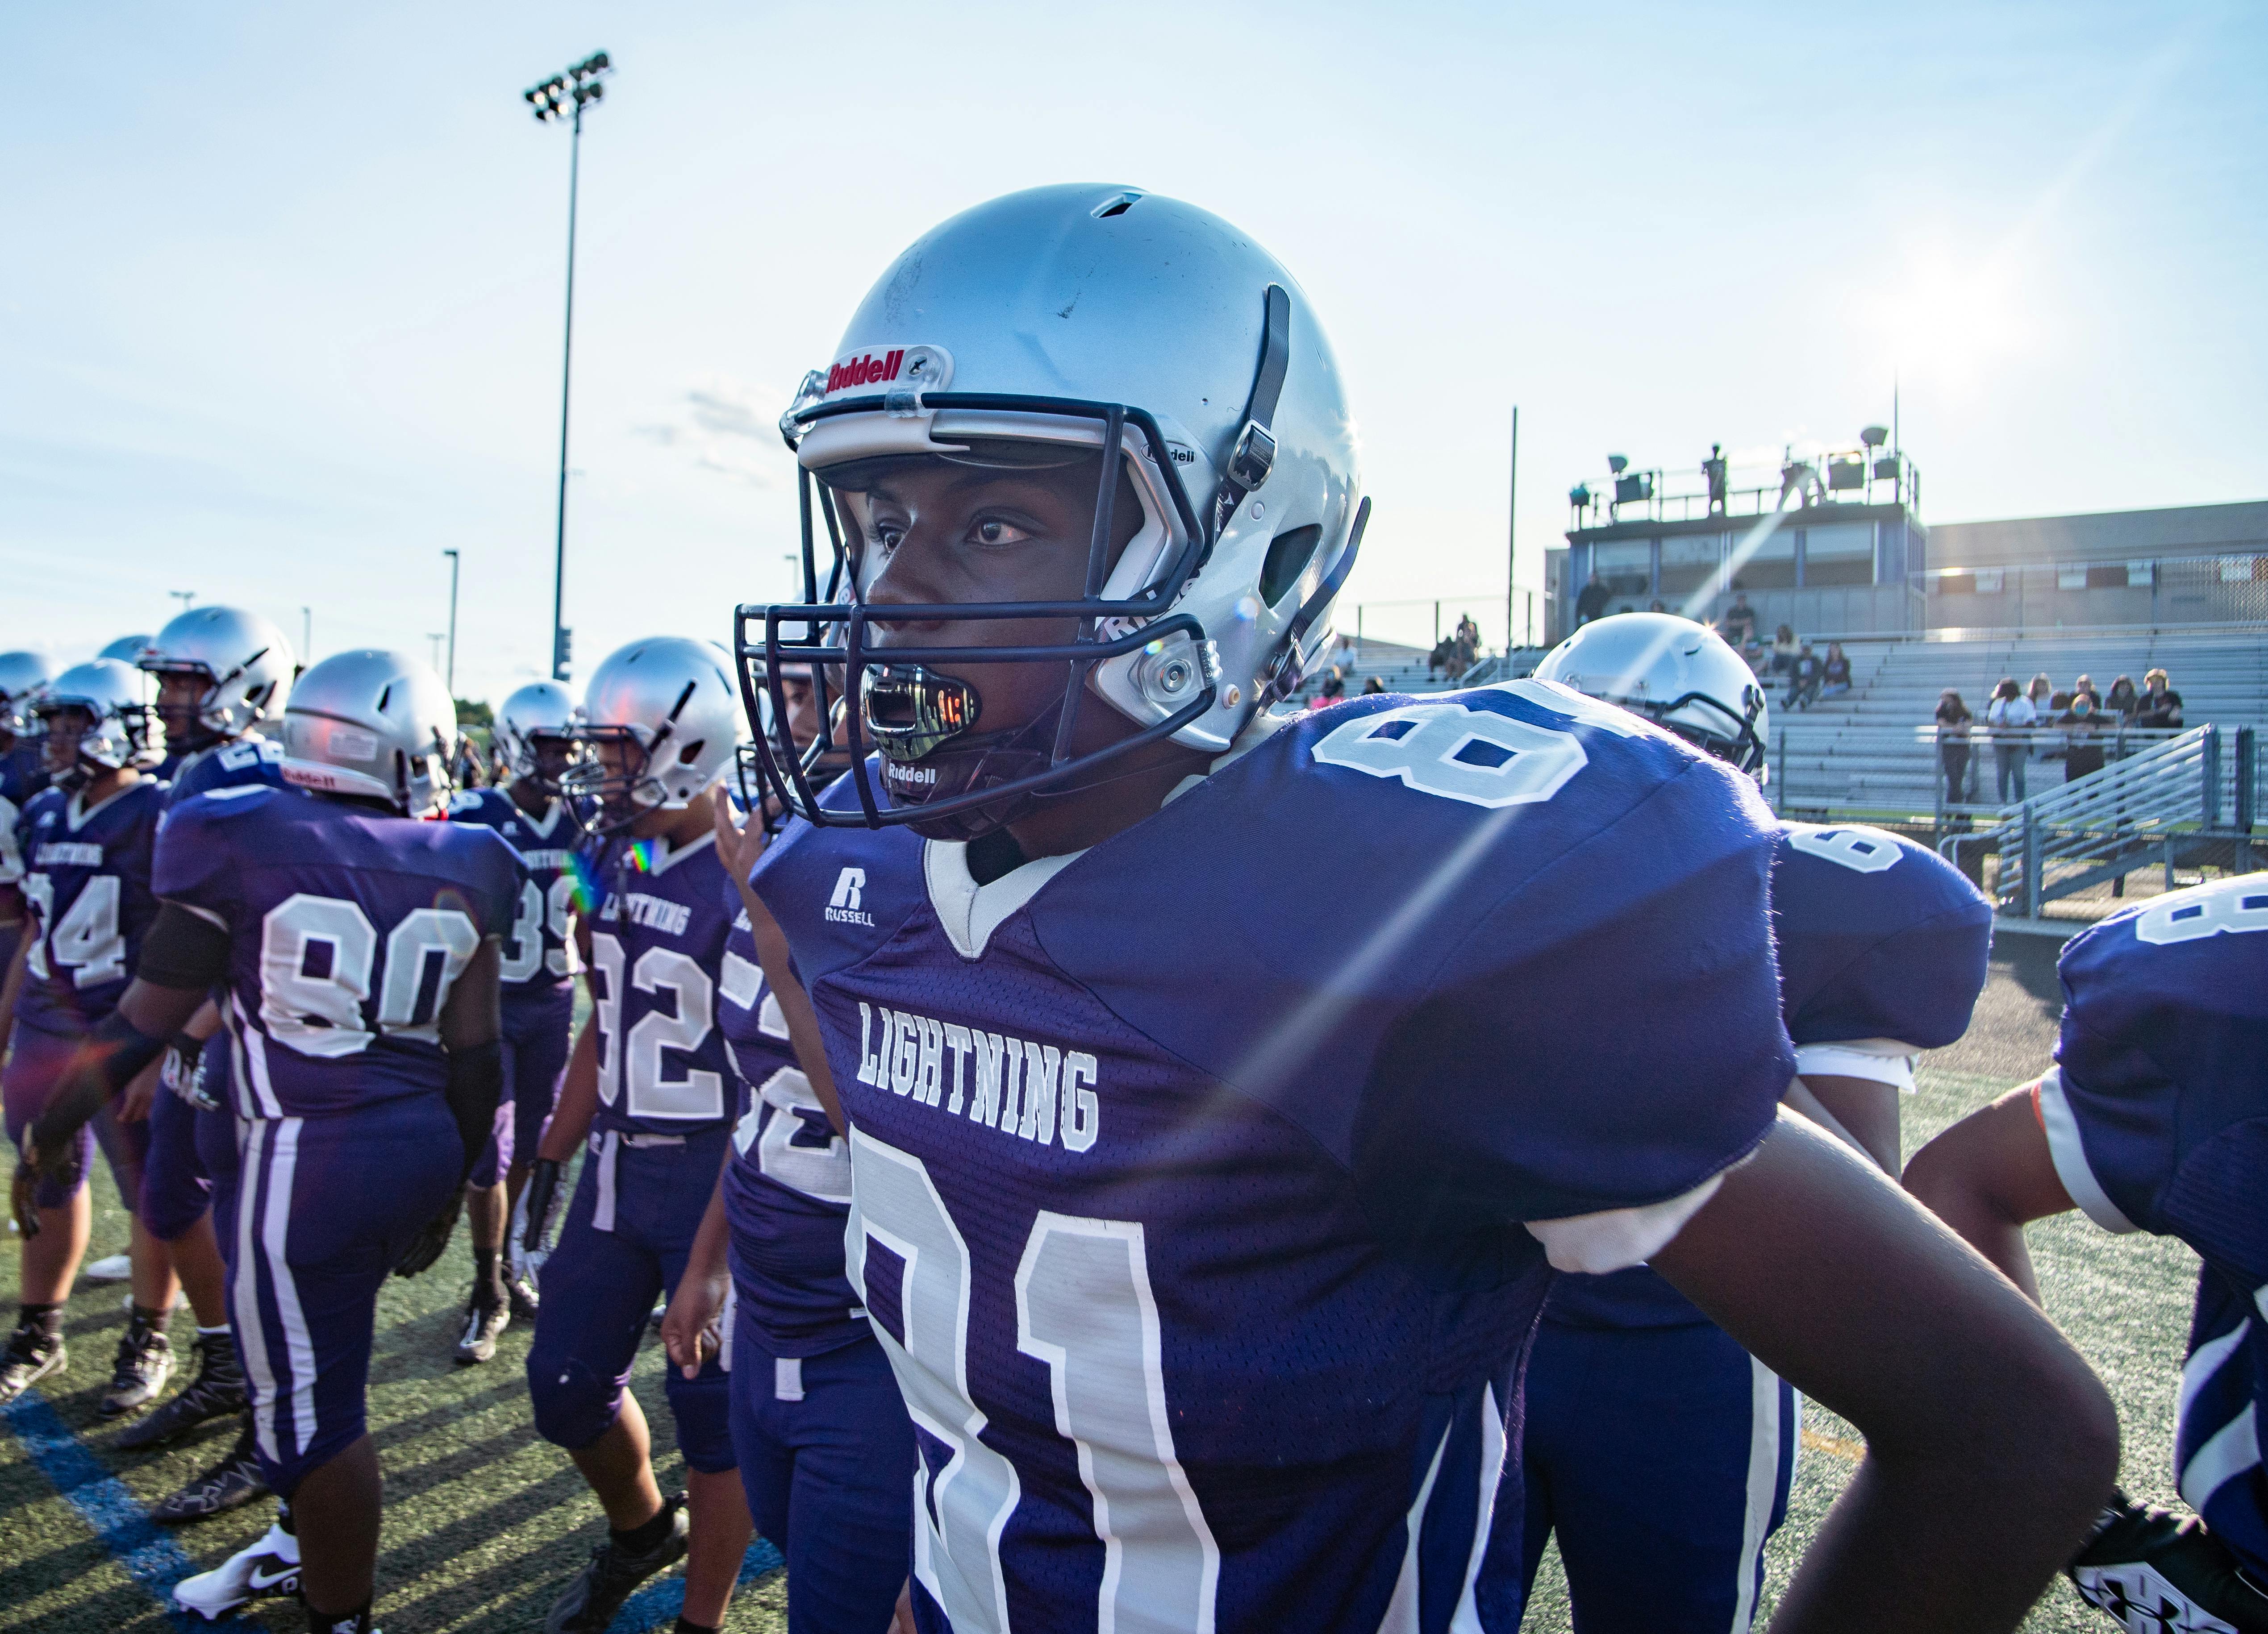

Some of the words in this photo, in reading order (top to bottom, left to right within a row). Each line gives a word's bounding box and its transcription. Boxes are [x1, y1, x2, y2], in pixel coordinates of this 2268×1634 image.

[825, 349, 905, 393] Riddell
[1147, 445, 1195, 462] Rdell
[889, 762, 936, 784] Riddell
[825, 906, 875, 927] RUSSELL
[857, 1002, 1099, 1153] LIGHTNING
